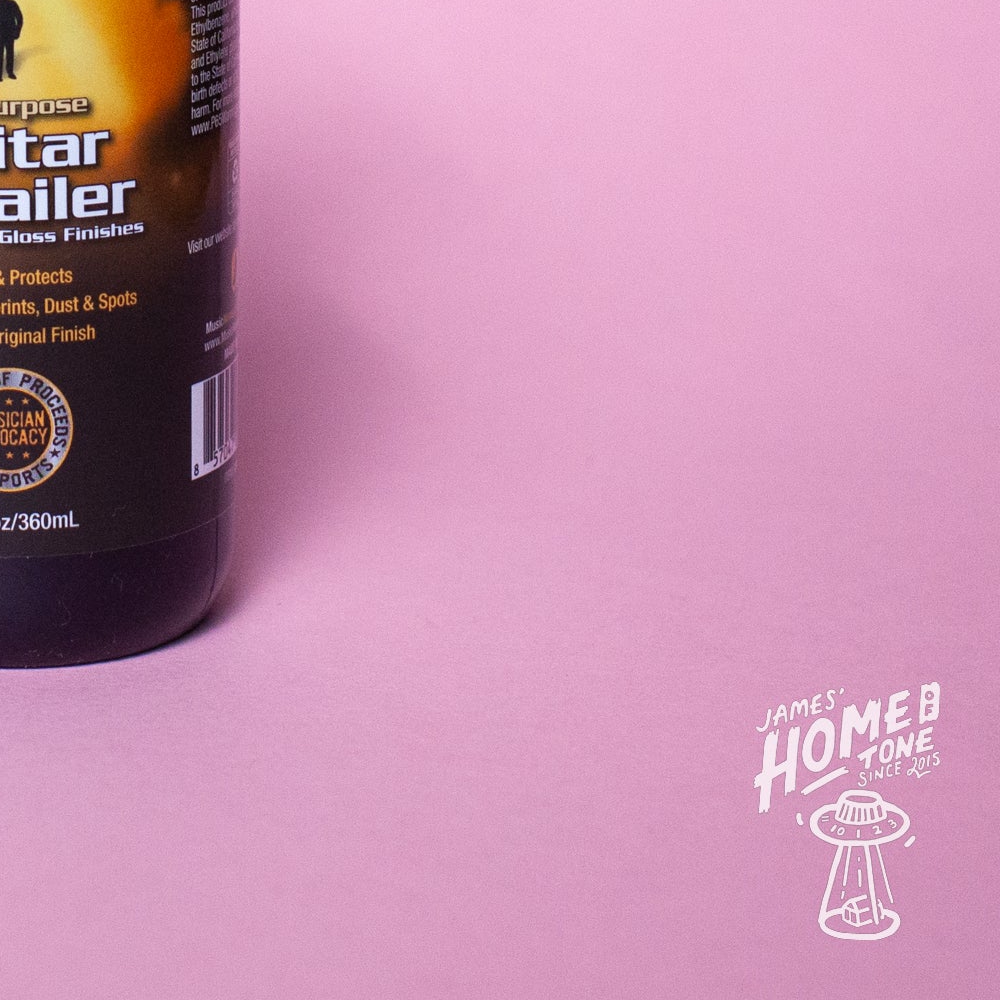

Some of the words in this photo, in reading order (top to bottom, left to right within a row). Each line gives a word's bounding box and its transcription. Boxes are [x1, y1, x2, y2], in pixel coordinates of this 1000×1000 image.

[190, 4, 207, 20] This
[190, 36, 210, 54] State
[190, 53, 205, 70] and
[191, 73, 199, 87] to
[200, 69, 211, 84] the
[191, 86, 208, 104] birth
[63, 219, 144, 242] Finishes
[187, 237, 203, 254] Visit
[203, 234, 215, 249] our
[10, 267, 73, 286] Protects
[44, 297, 79, 315] Dust
[83, 294, 95, 312] &
[98, 289, 138, 310] Spots
[51, 323, 96, 343] Finish
[18, 373, 69, 449] PROCEEDS
[193, 463, 200, 477] 8
